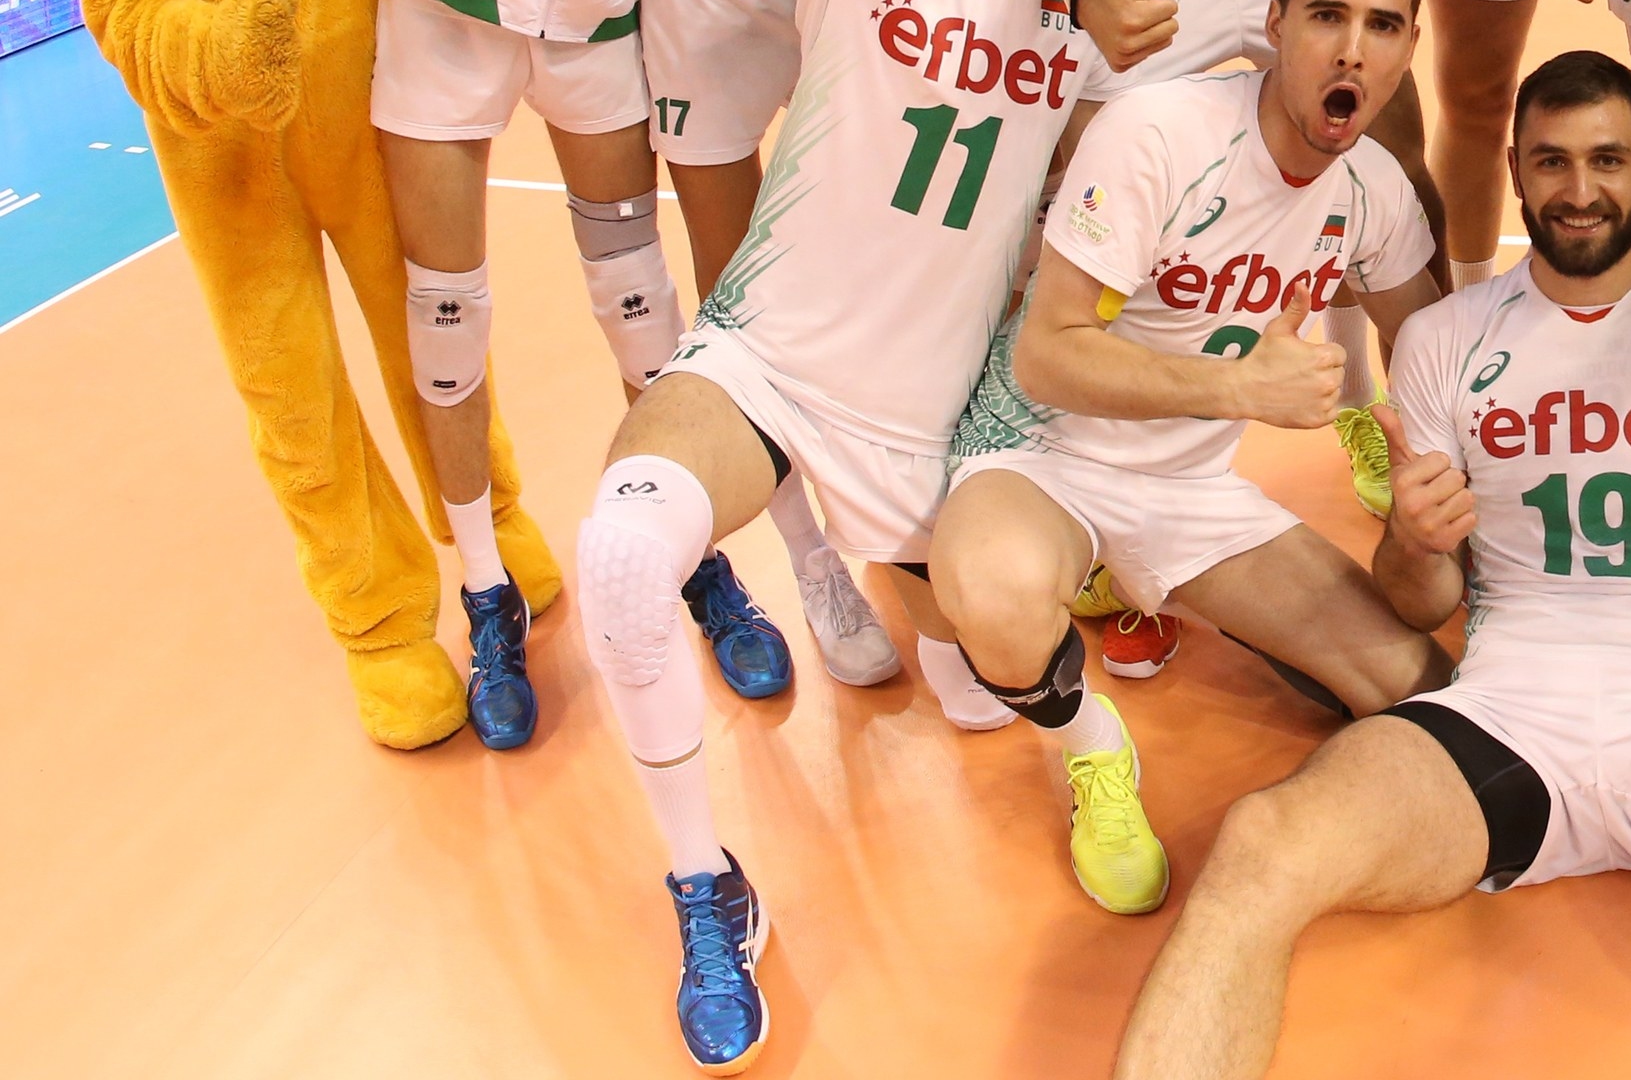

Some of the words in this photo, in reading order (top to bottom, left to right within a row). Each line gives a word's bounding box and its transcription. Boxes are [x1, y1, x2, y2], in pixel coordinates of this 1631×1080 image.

[1041, 10, 1077, 35] BUL
[879, 7, 1079, 110] efbet
[654, 96, 691, 136] 17
[890, 103, 1004, 230] 11
[1313, 236, 1343, 253] BUL
[1156, 253, 1344, 314] efbet
[435, 316, 461, 326] errea
[623, 306, 650, 320] errea
